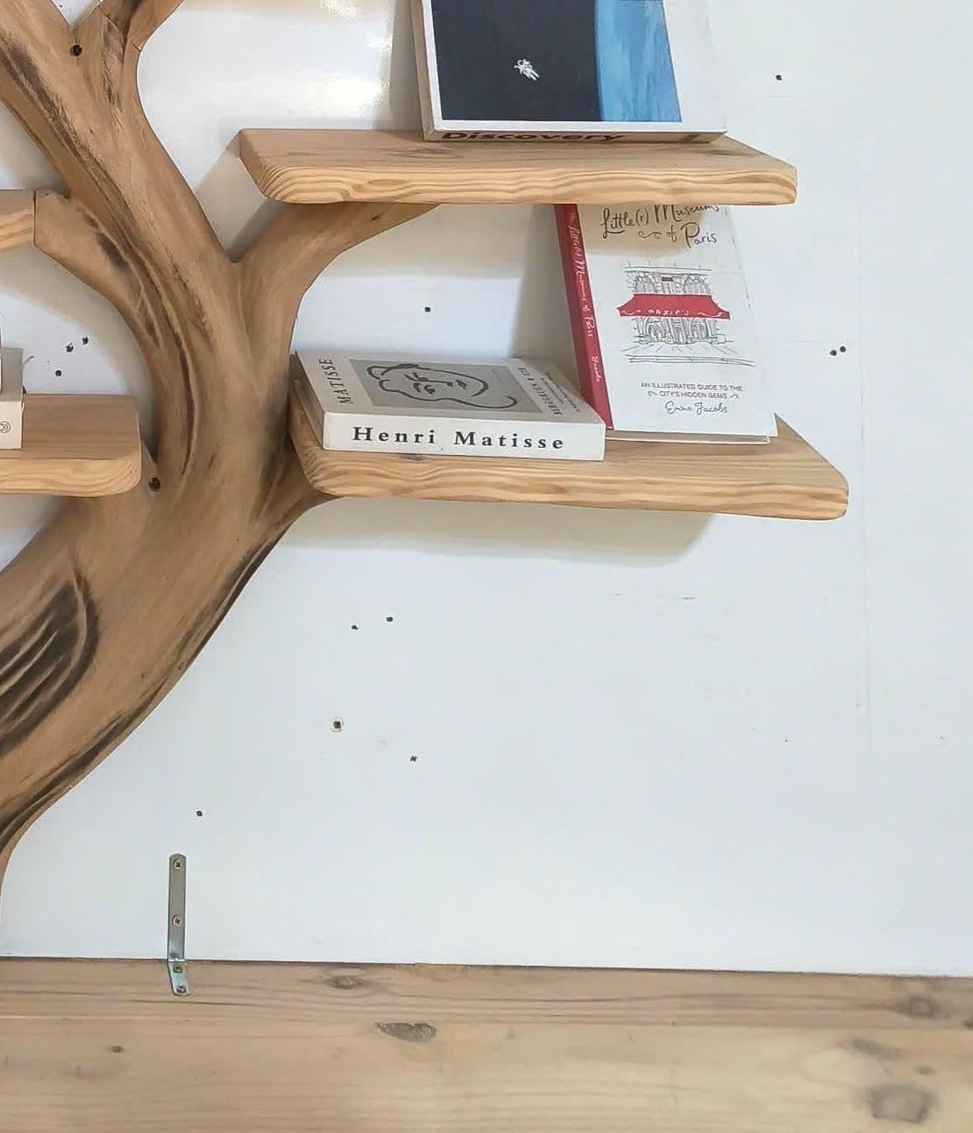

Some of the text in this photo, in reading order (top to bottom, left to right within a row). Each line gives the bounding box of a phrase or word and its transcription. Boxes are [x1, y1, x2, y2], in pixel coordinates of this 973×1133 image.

[441, 132, 627, 141] Discovery
[600, 204, 721, 240] Little(r) Museums
[666, 221, 718, 249] of Paris
[317, 358, 355, 406] MATISSE
[651, 381, 696, 391] ILLUSTRATED
[696, 383, 718, 392] GUIDE
[718, 384, 729, 392] TO
[729, 384, 744, 393] THE
[707, 391, 728, 400] GEMS
[694, 402, 729, 416] Jacobs
[353, 426, 565, 449] Henri Matisse
